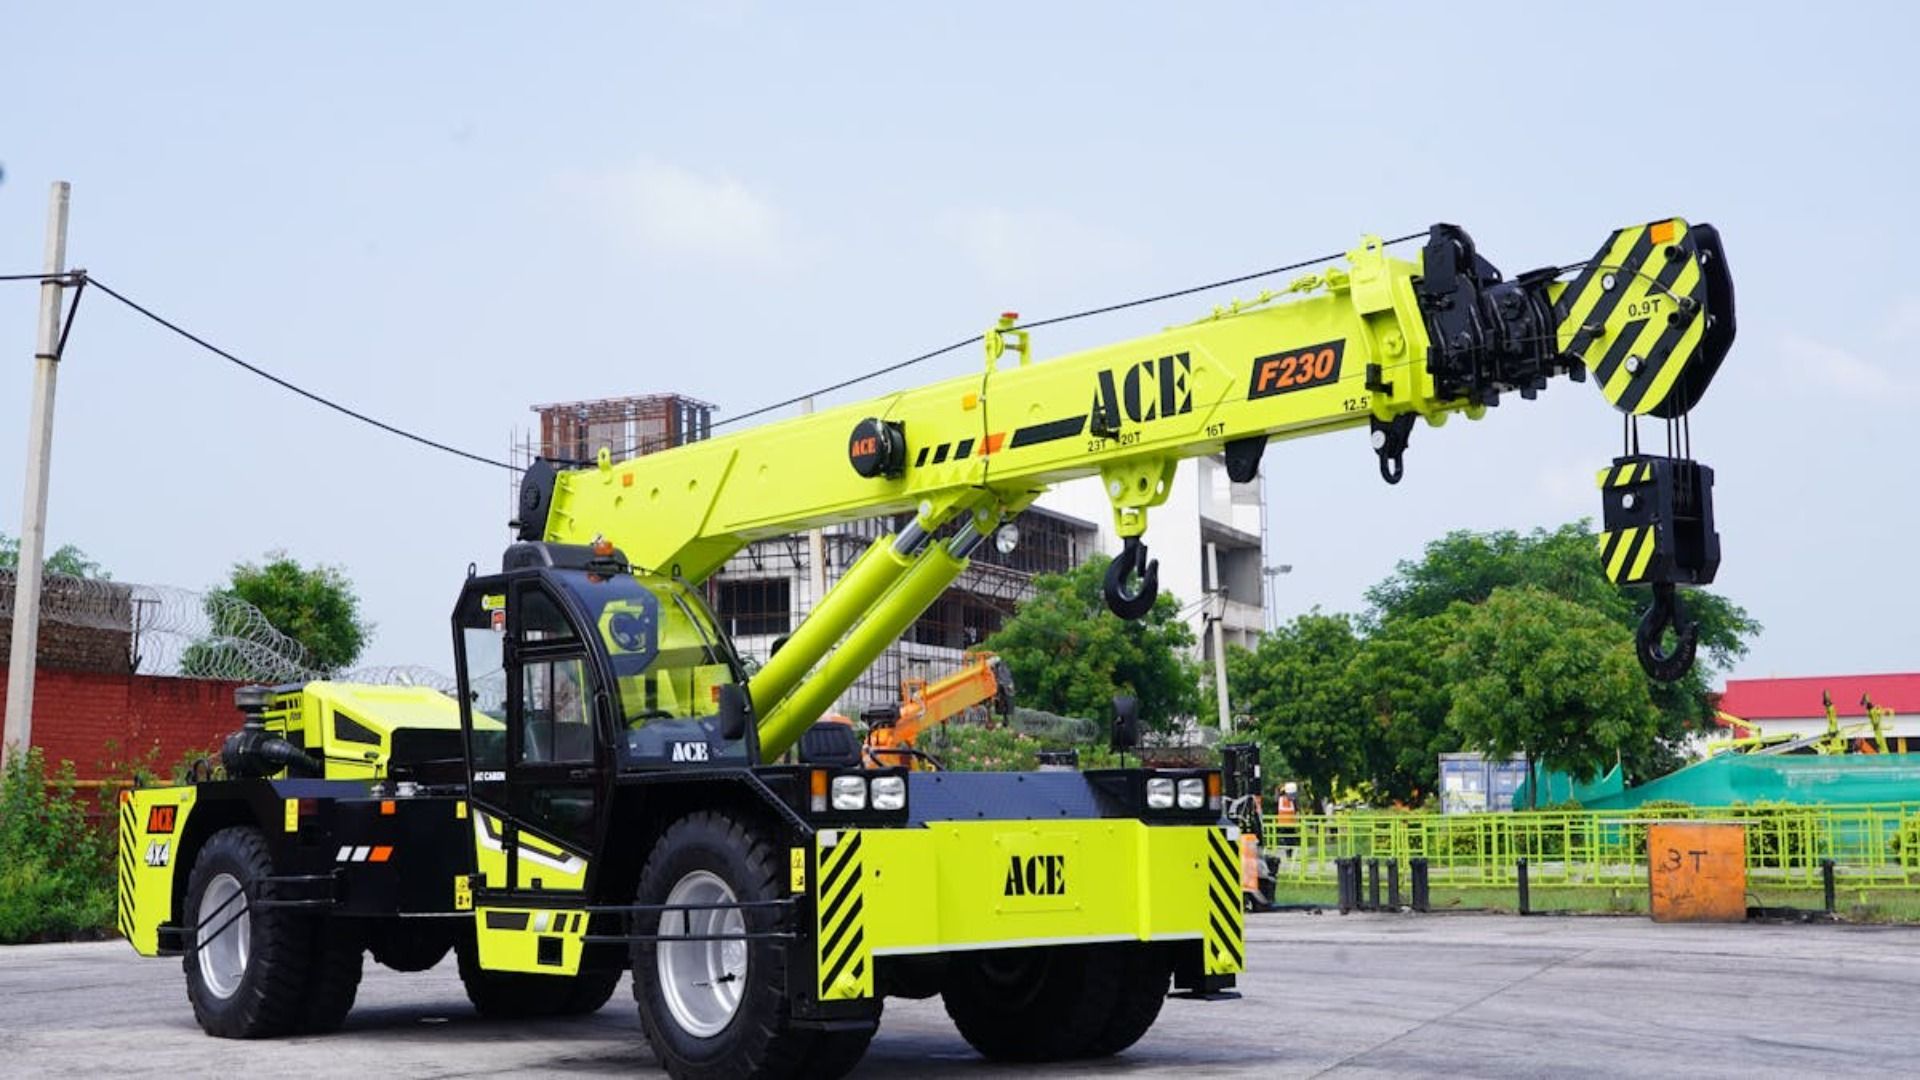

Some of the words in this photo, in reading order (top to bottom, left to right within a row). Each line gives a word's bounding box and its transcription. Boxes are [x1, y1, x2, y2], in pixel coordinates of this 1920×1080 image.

[1628, 299, 1661, 317] 0.9T
[1257, 349, 1335, 391] F230
[1090, 351, 1193, 435] ACE
[1343, 395, 1371, 411] 12.5
[1121, 431, 1140, 445] 20T
[1206, 423, 1225, 437] 16T
[851, 437, 876, 457] ACE
[672, 741, 709, 762] ACE
[149, 807, 174, 832] ACE
[1004, 855, 1065, 896] ACE
